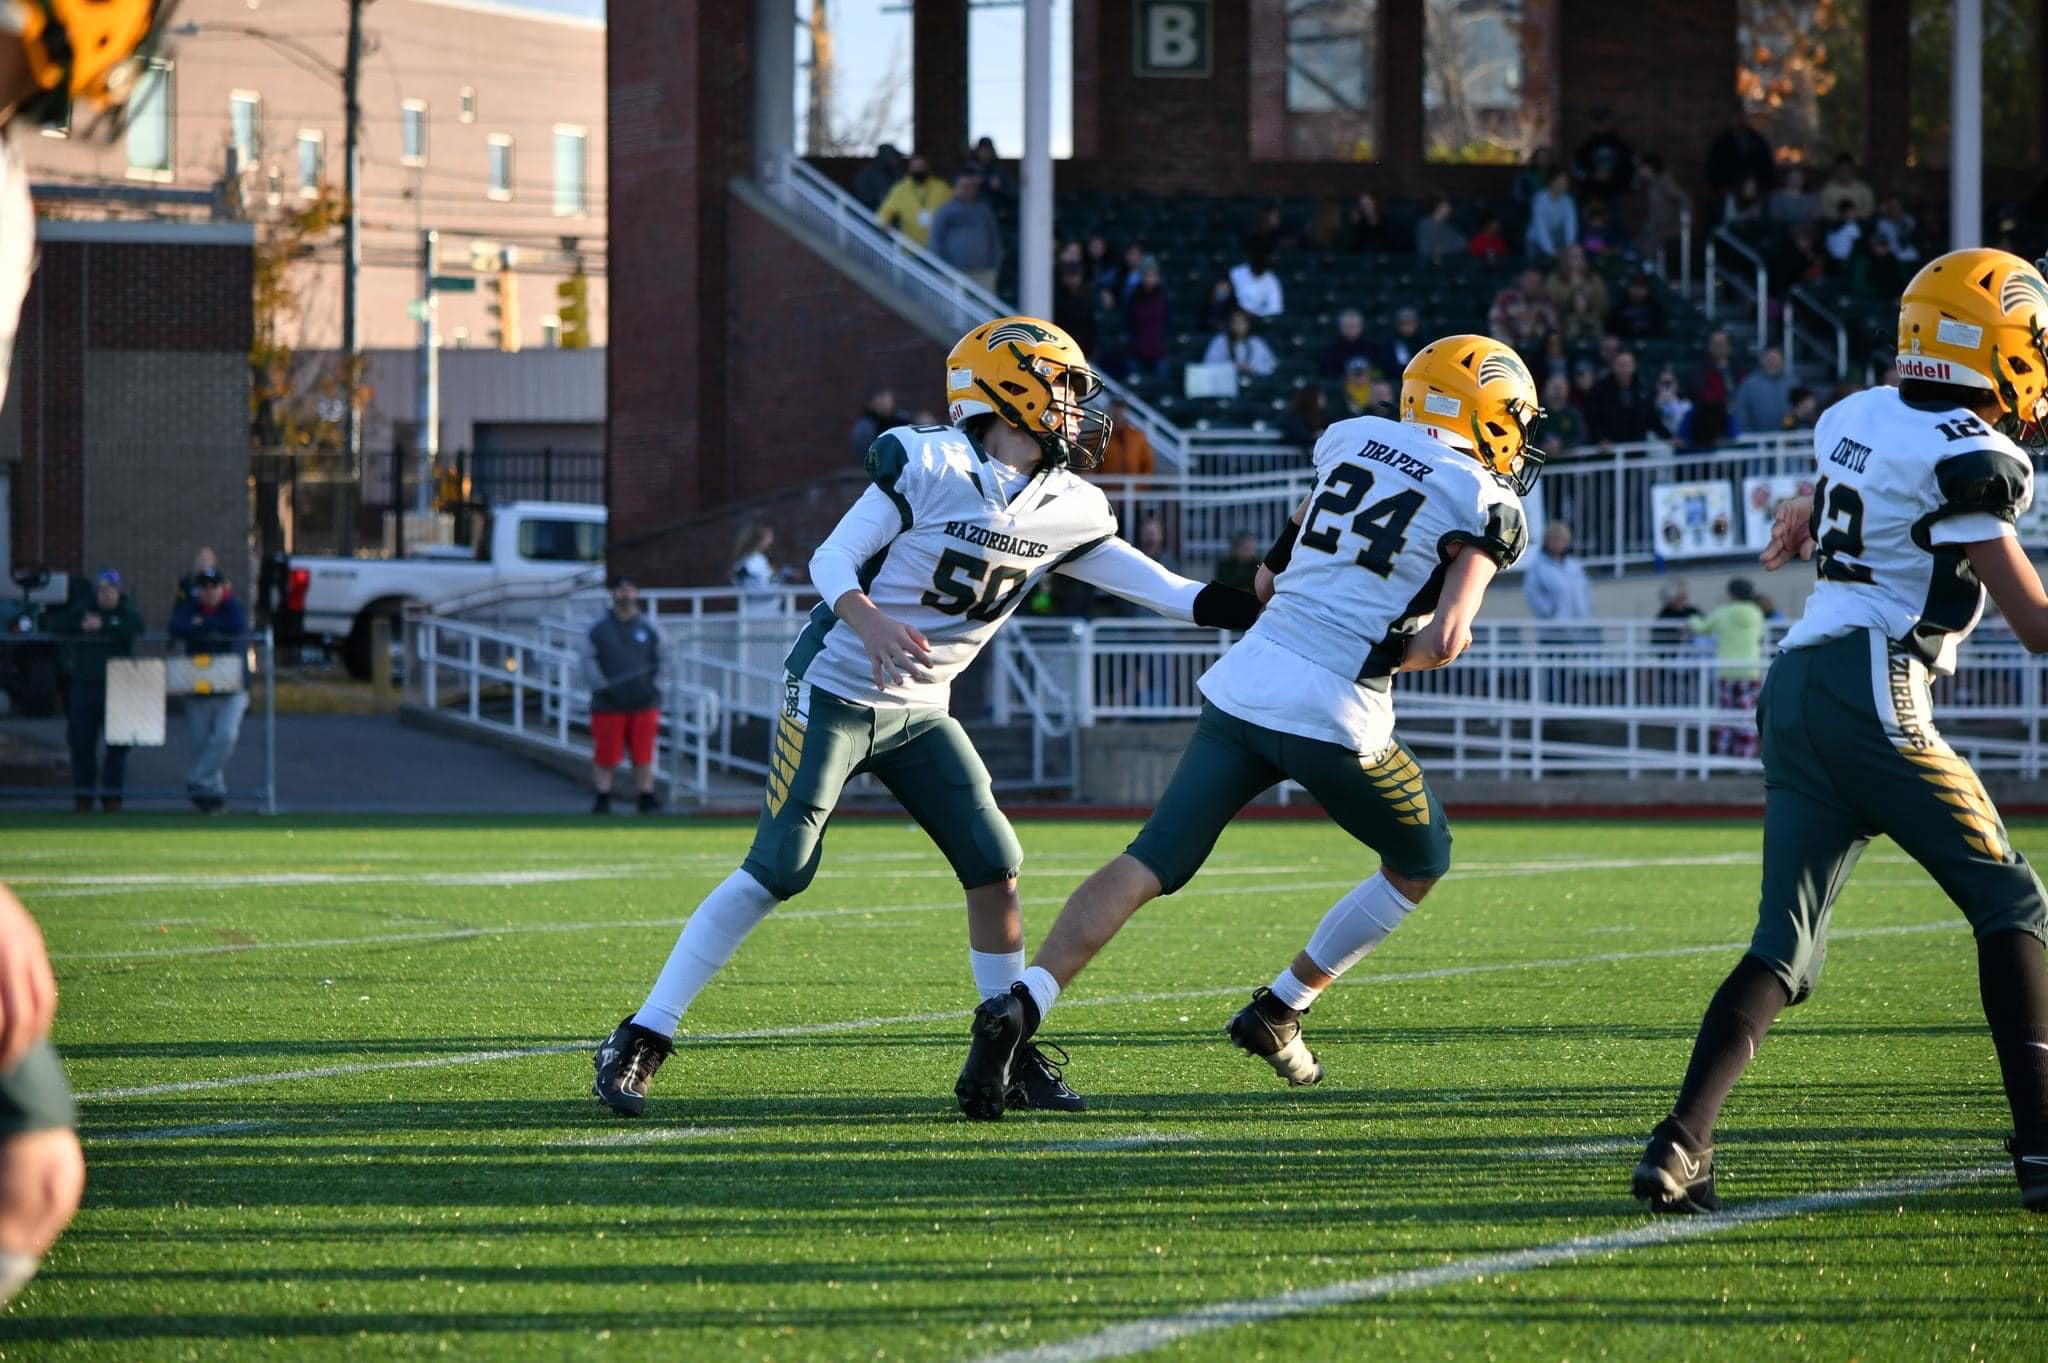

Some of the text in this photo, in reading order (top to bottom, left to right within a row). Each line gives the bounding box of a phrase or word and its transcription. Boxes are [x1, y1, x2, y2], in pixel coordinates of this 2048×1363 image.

[1149, 6, 1197, 66] B
[1935, 416, 1990, 442] 12
[1357, 439, 1434, 483] DRAPER
[1829, 436, 1873, 475] ORTIZ
[943, 520, 1049, 559] RAZORBACKS
[1300, 461, 1427, 581] 24
[1809, 474, 1879, 586] 12
[920, 547, 1028, 624] 50
